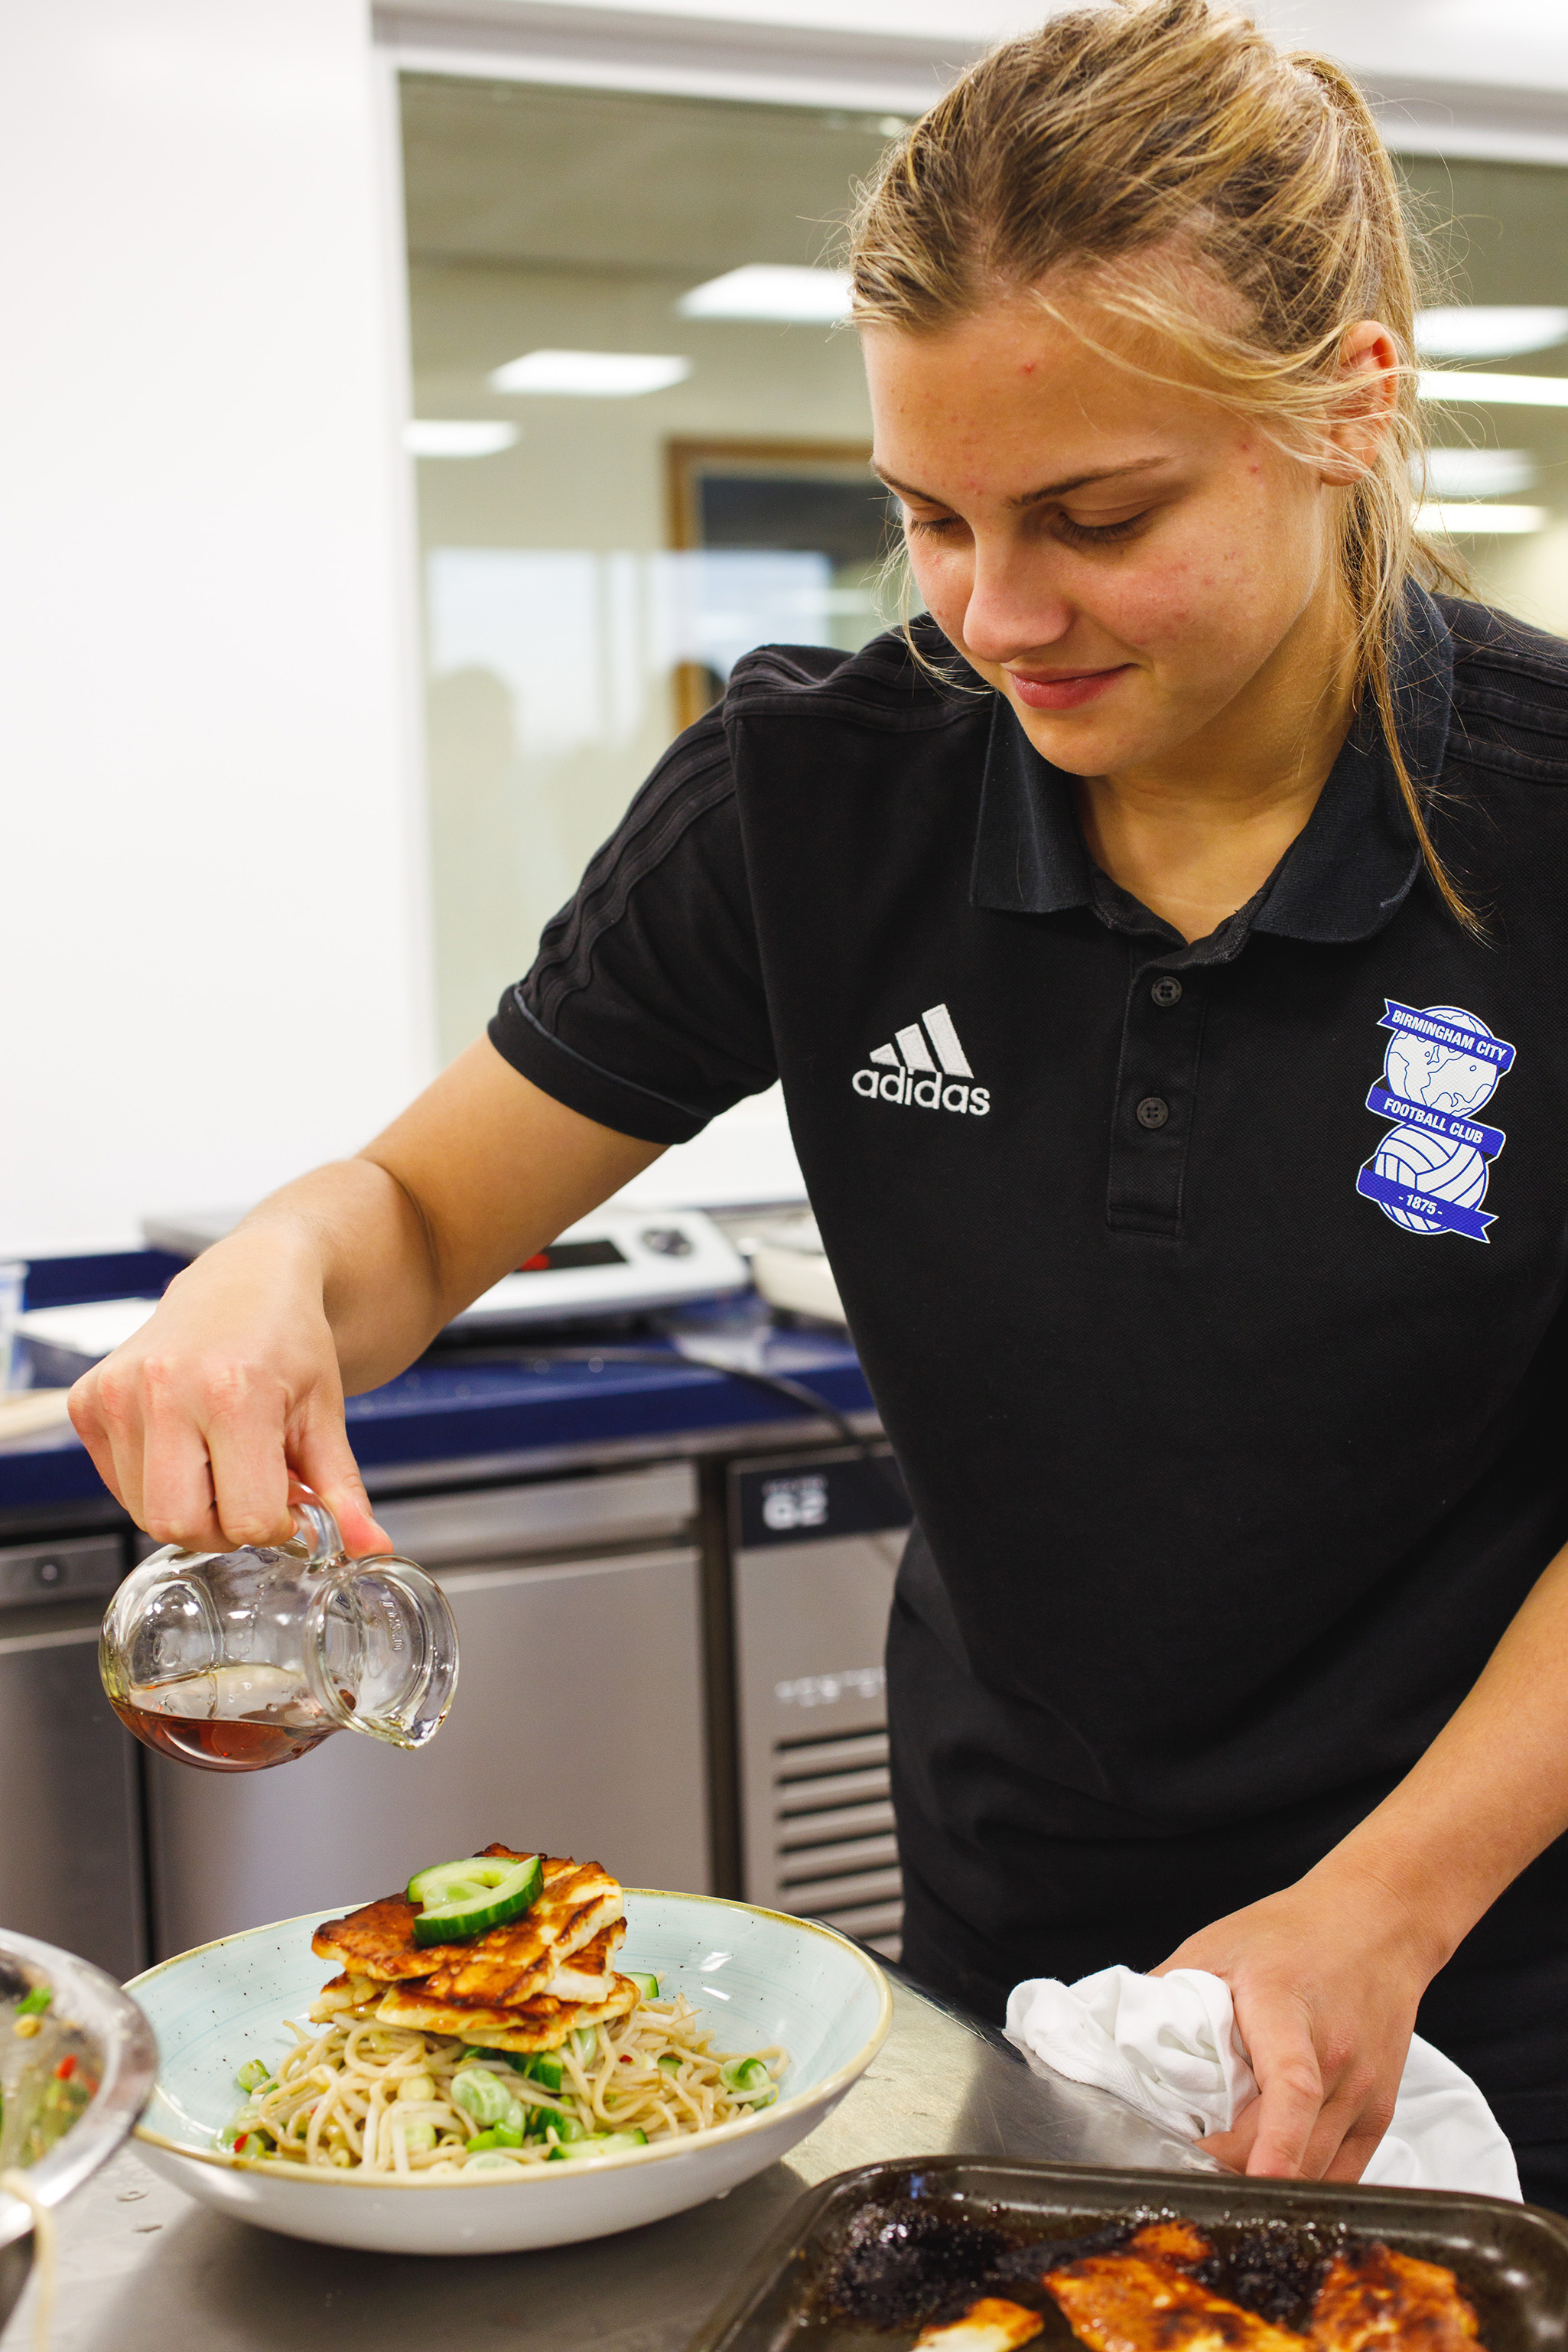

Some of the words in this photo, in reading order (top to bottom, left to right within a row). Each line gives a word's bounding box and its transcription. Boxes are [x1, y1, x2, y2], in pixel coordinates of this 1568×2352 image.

[1391, 1009, 1475, 1051] BIRMINGHAM
[1475, 1039, 1508, 1062] CITY
[851, 1065, 991, 1117] adidas
[1383, 1097, 1446, 1132] FOOTBALL
[1449, 1121, 1484, 1144] CLUB
